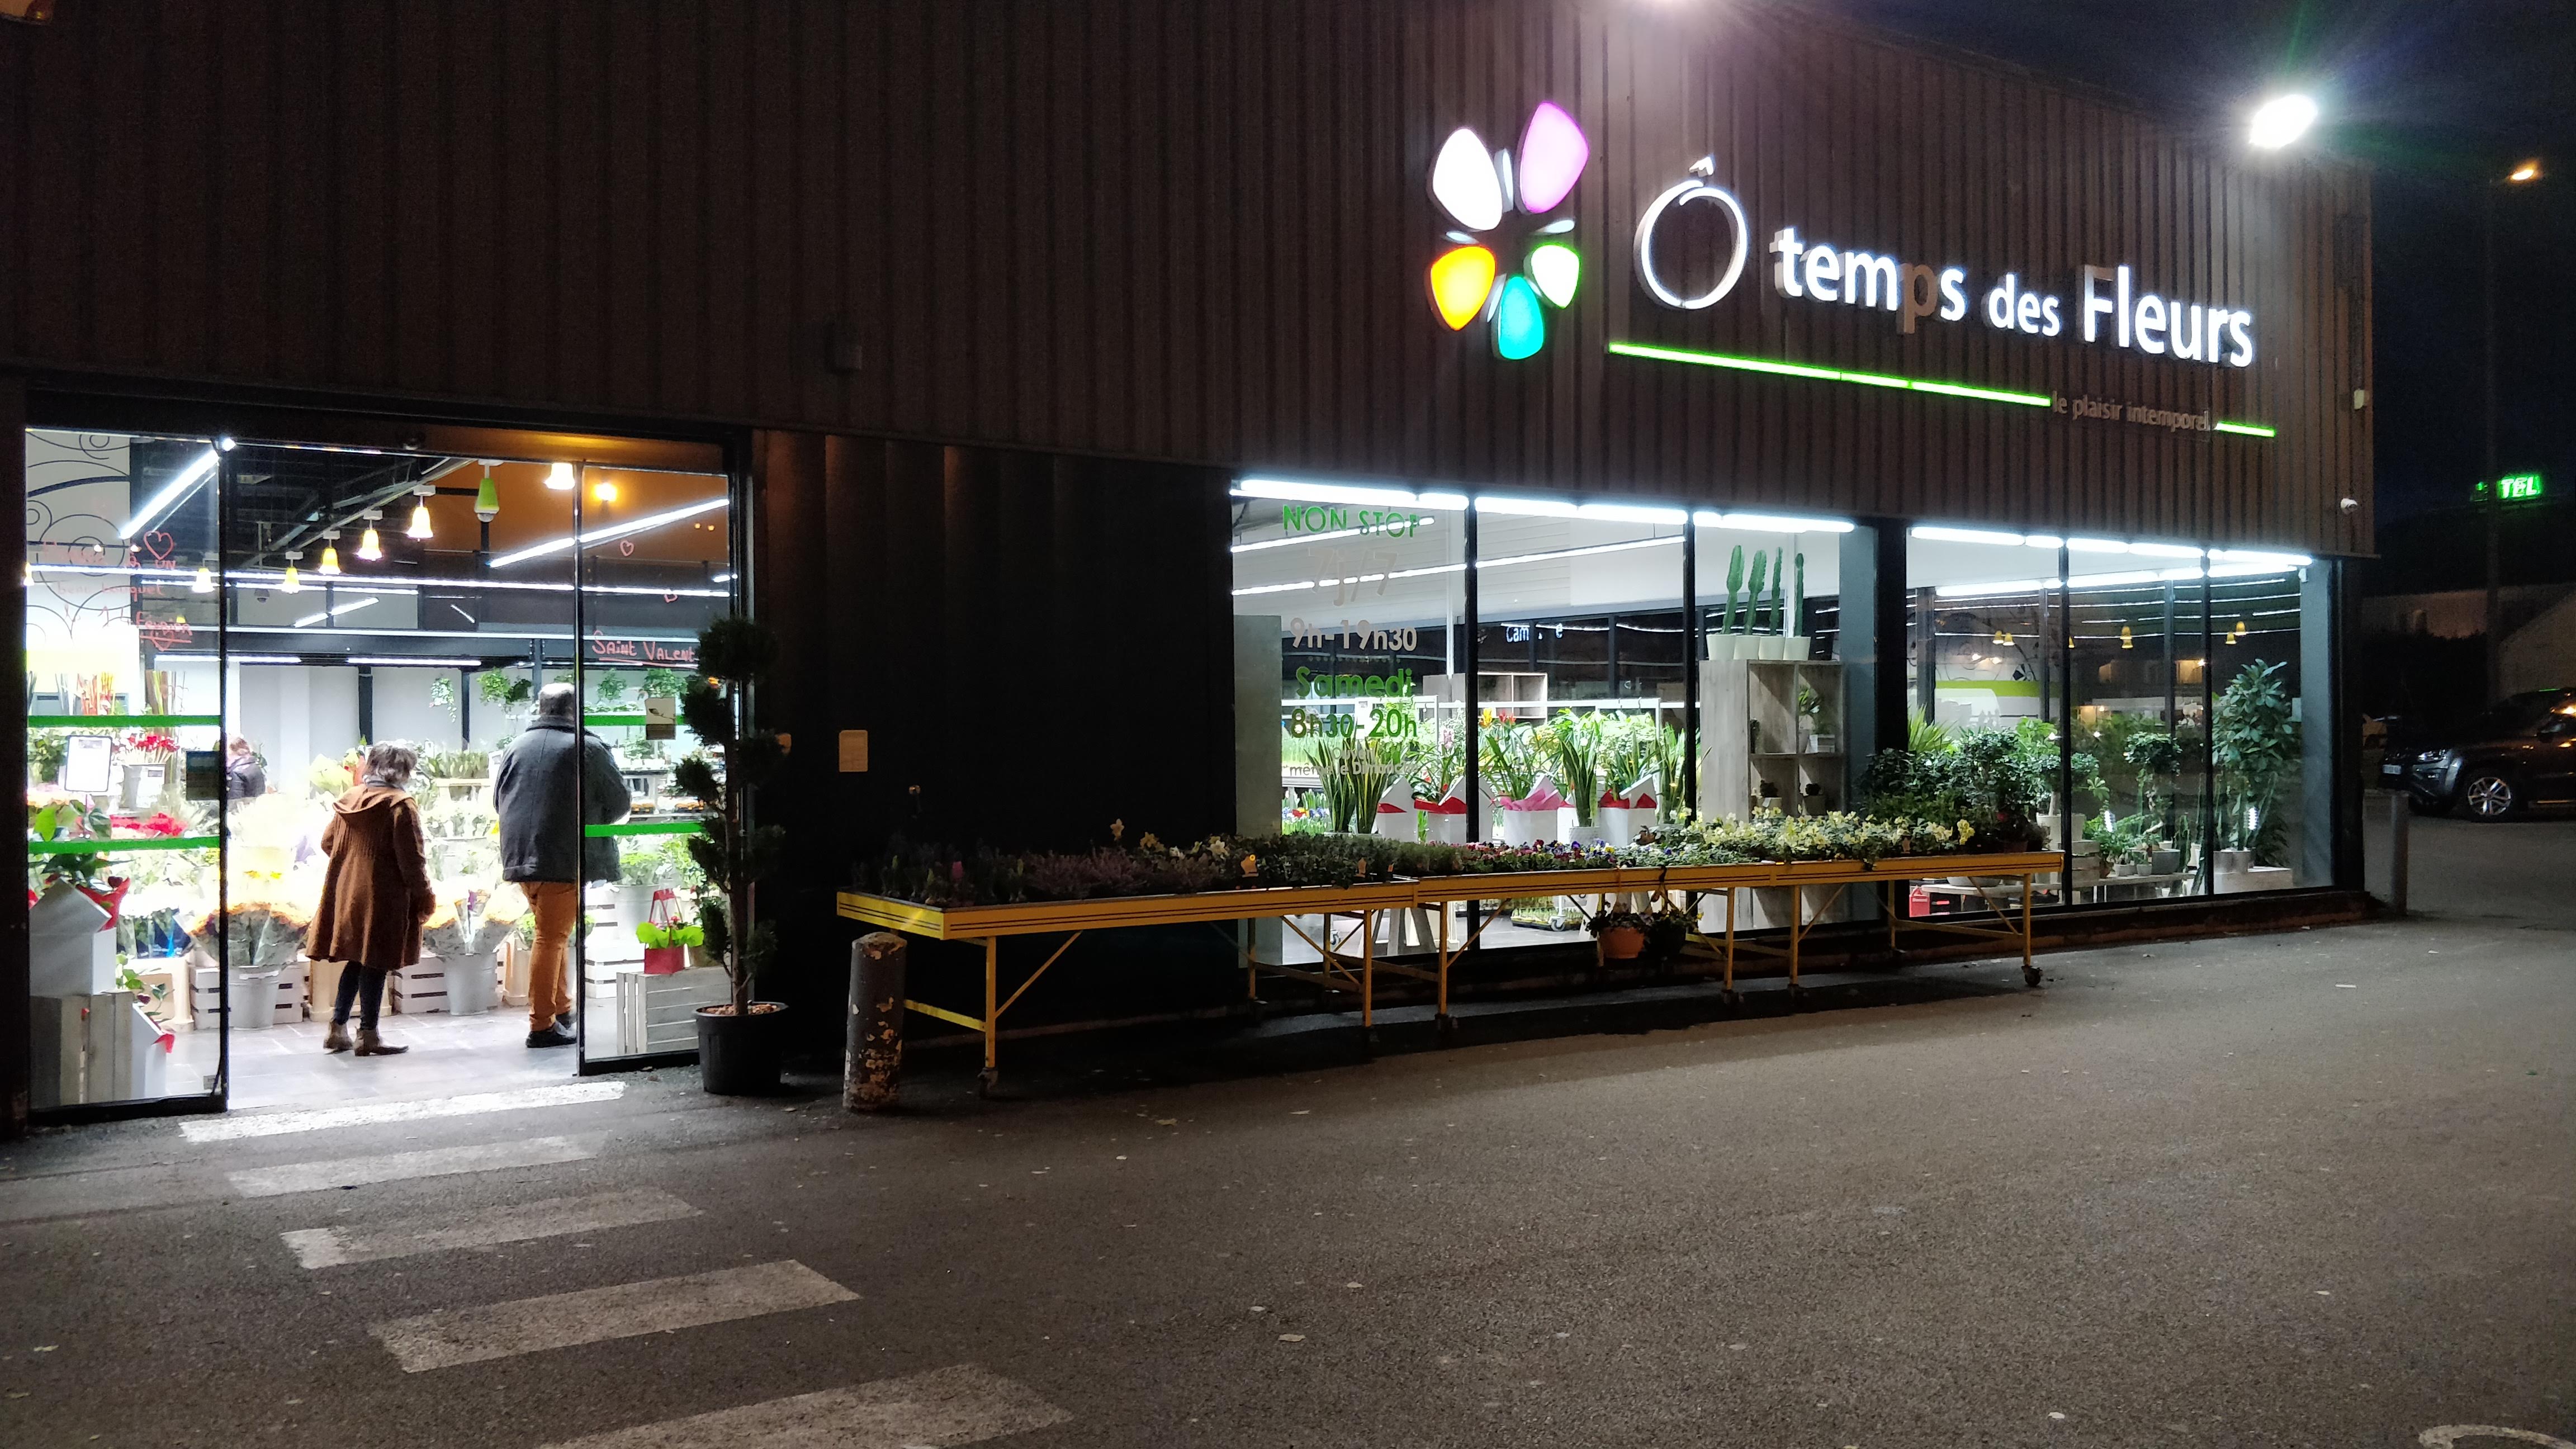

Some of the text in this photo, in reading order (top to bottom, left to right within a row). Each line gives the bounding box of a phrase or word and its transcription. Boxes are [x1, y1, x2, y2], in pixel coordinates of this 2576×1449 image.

[1769, 226, 1968, 334] temps
[1983, 272, 2062, 337] des
[2077, 264, 2254, 368] Fleurs
[2052, 390, 2211, 432] le plaisir intemporel
[1282, 504, 1420, 538] NON STOP
[1295, 666, 1413, 698] Samedi
